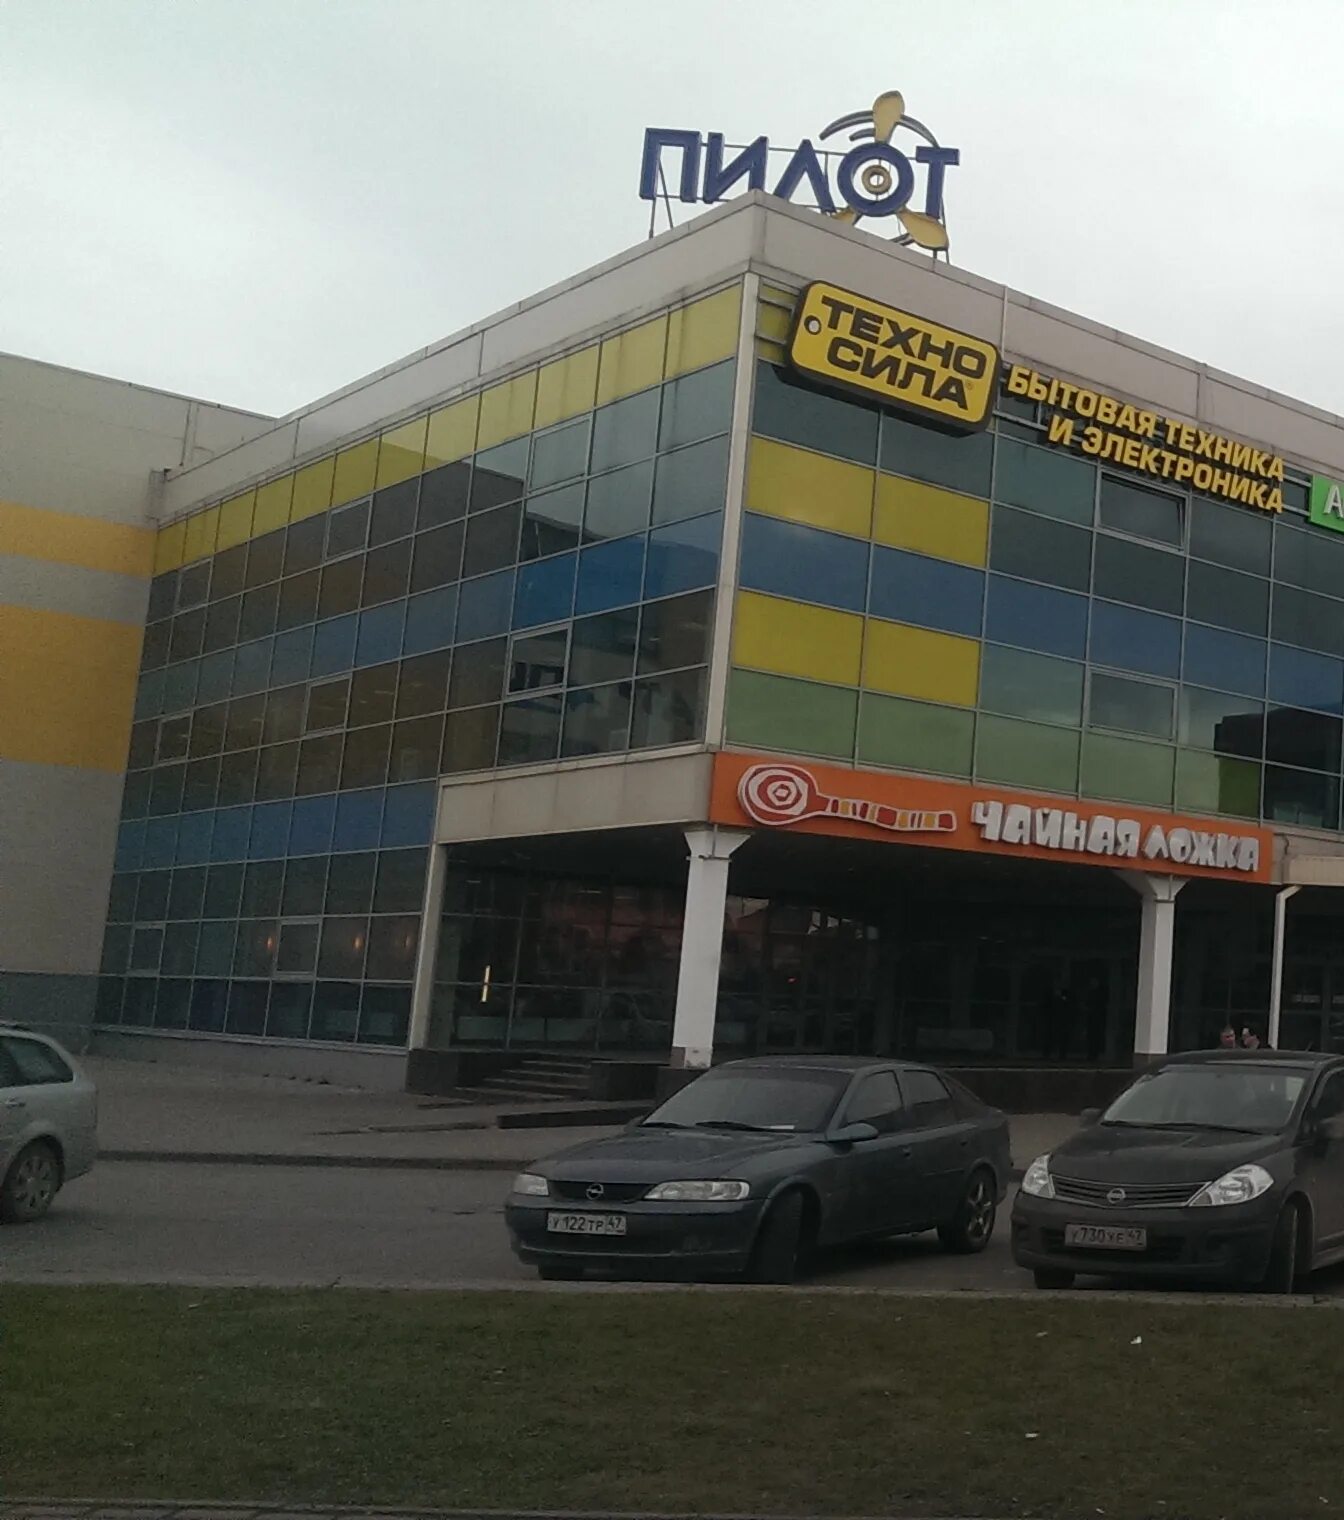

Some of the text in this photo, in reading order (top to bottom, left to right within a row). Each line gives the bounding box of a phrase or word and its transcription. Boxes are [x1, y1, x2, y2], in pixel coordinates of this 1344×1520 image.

[639, 127, 960, 219] ПИЛОТ
[820, 294, 987, 379] ТЕХНО
[827, 336, 969, 411] СИЛА
[1007, 363, 1285, 482] БЫТОВАЯ ТЕХНИКА
[1047, 413, 1284, 514] И ЭЛЕКТРОНИКА
[971, 801, 1260, 873] ЧАЙНАЯ ЛОЖКА
